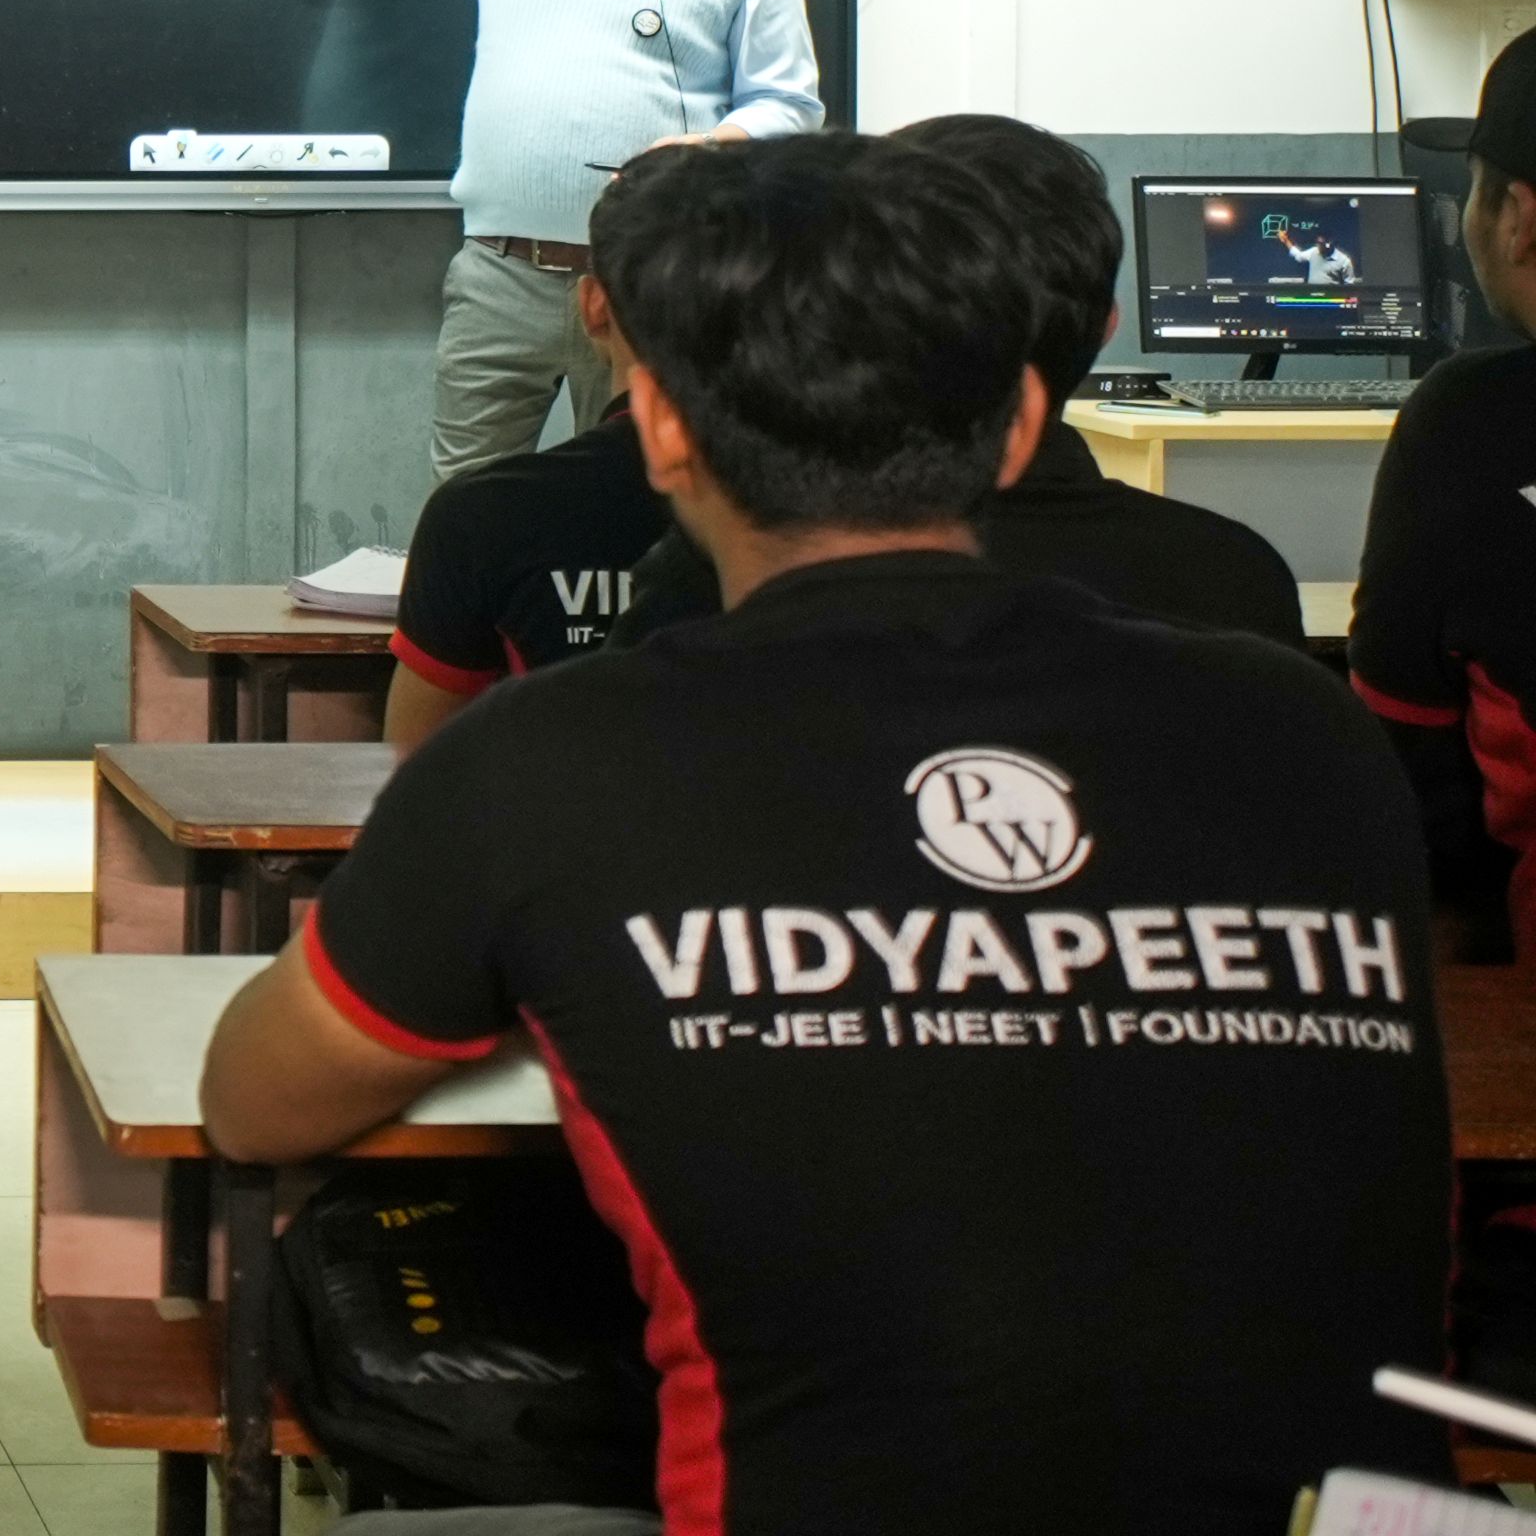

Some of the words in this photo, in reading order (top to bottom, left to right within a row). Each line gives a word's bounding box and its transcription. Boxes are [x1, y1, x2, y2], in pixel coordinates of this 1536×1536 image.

[624, 906, 1407, 1003] VIDYAPEETH
[669, 1010, 867, 1051] IIT-JEE
[914, 1010, 1063, 1046] NEET
[1107, 1009, 1412, 1054] FOUNDATION
